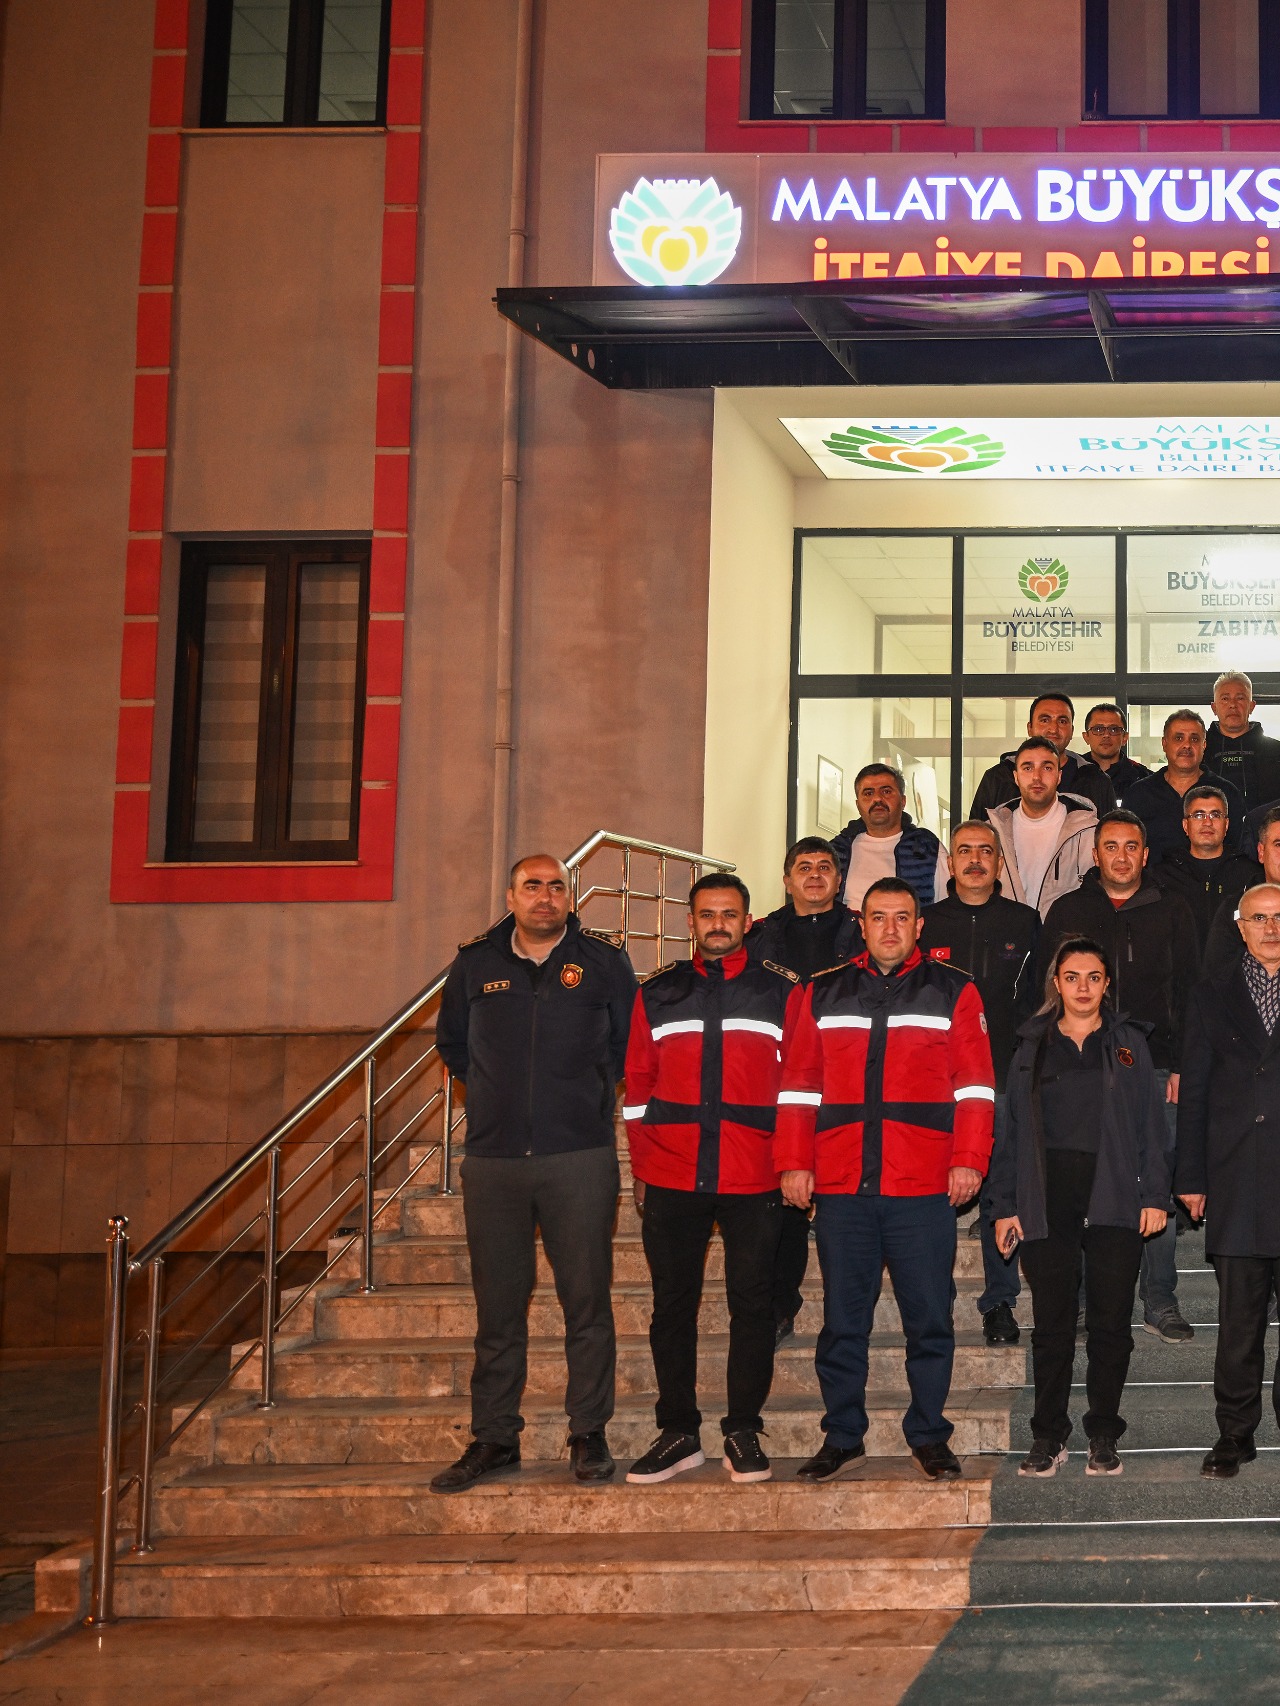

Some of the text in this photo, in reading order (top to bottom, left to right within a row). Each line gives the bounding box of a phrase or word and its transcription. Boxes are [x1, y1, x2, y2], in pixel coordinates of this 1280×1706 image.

[771, 177, 1022, 222] MALATYA
[1201, 593, 1274, 606] BELEDİYESİ
[1012, 607, 1074, 618] MALATYA
[983, 621, 1102, 640] BÜYÜKŞEHİR
[1198, 619, 1278, 636] ZABITA
[1011, 641, 1075, 652] BELEDİYESİ
